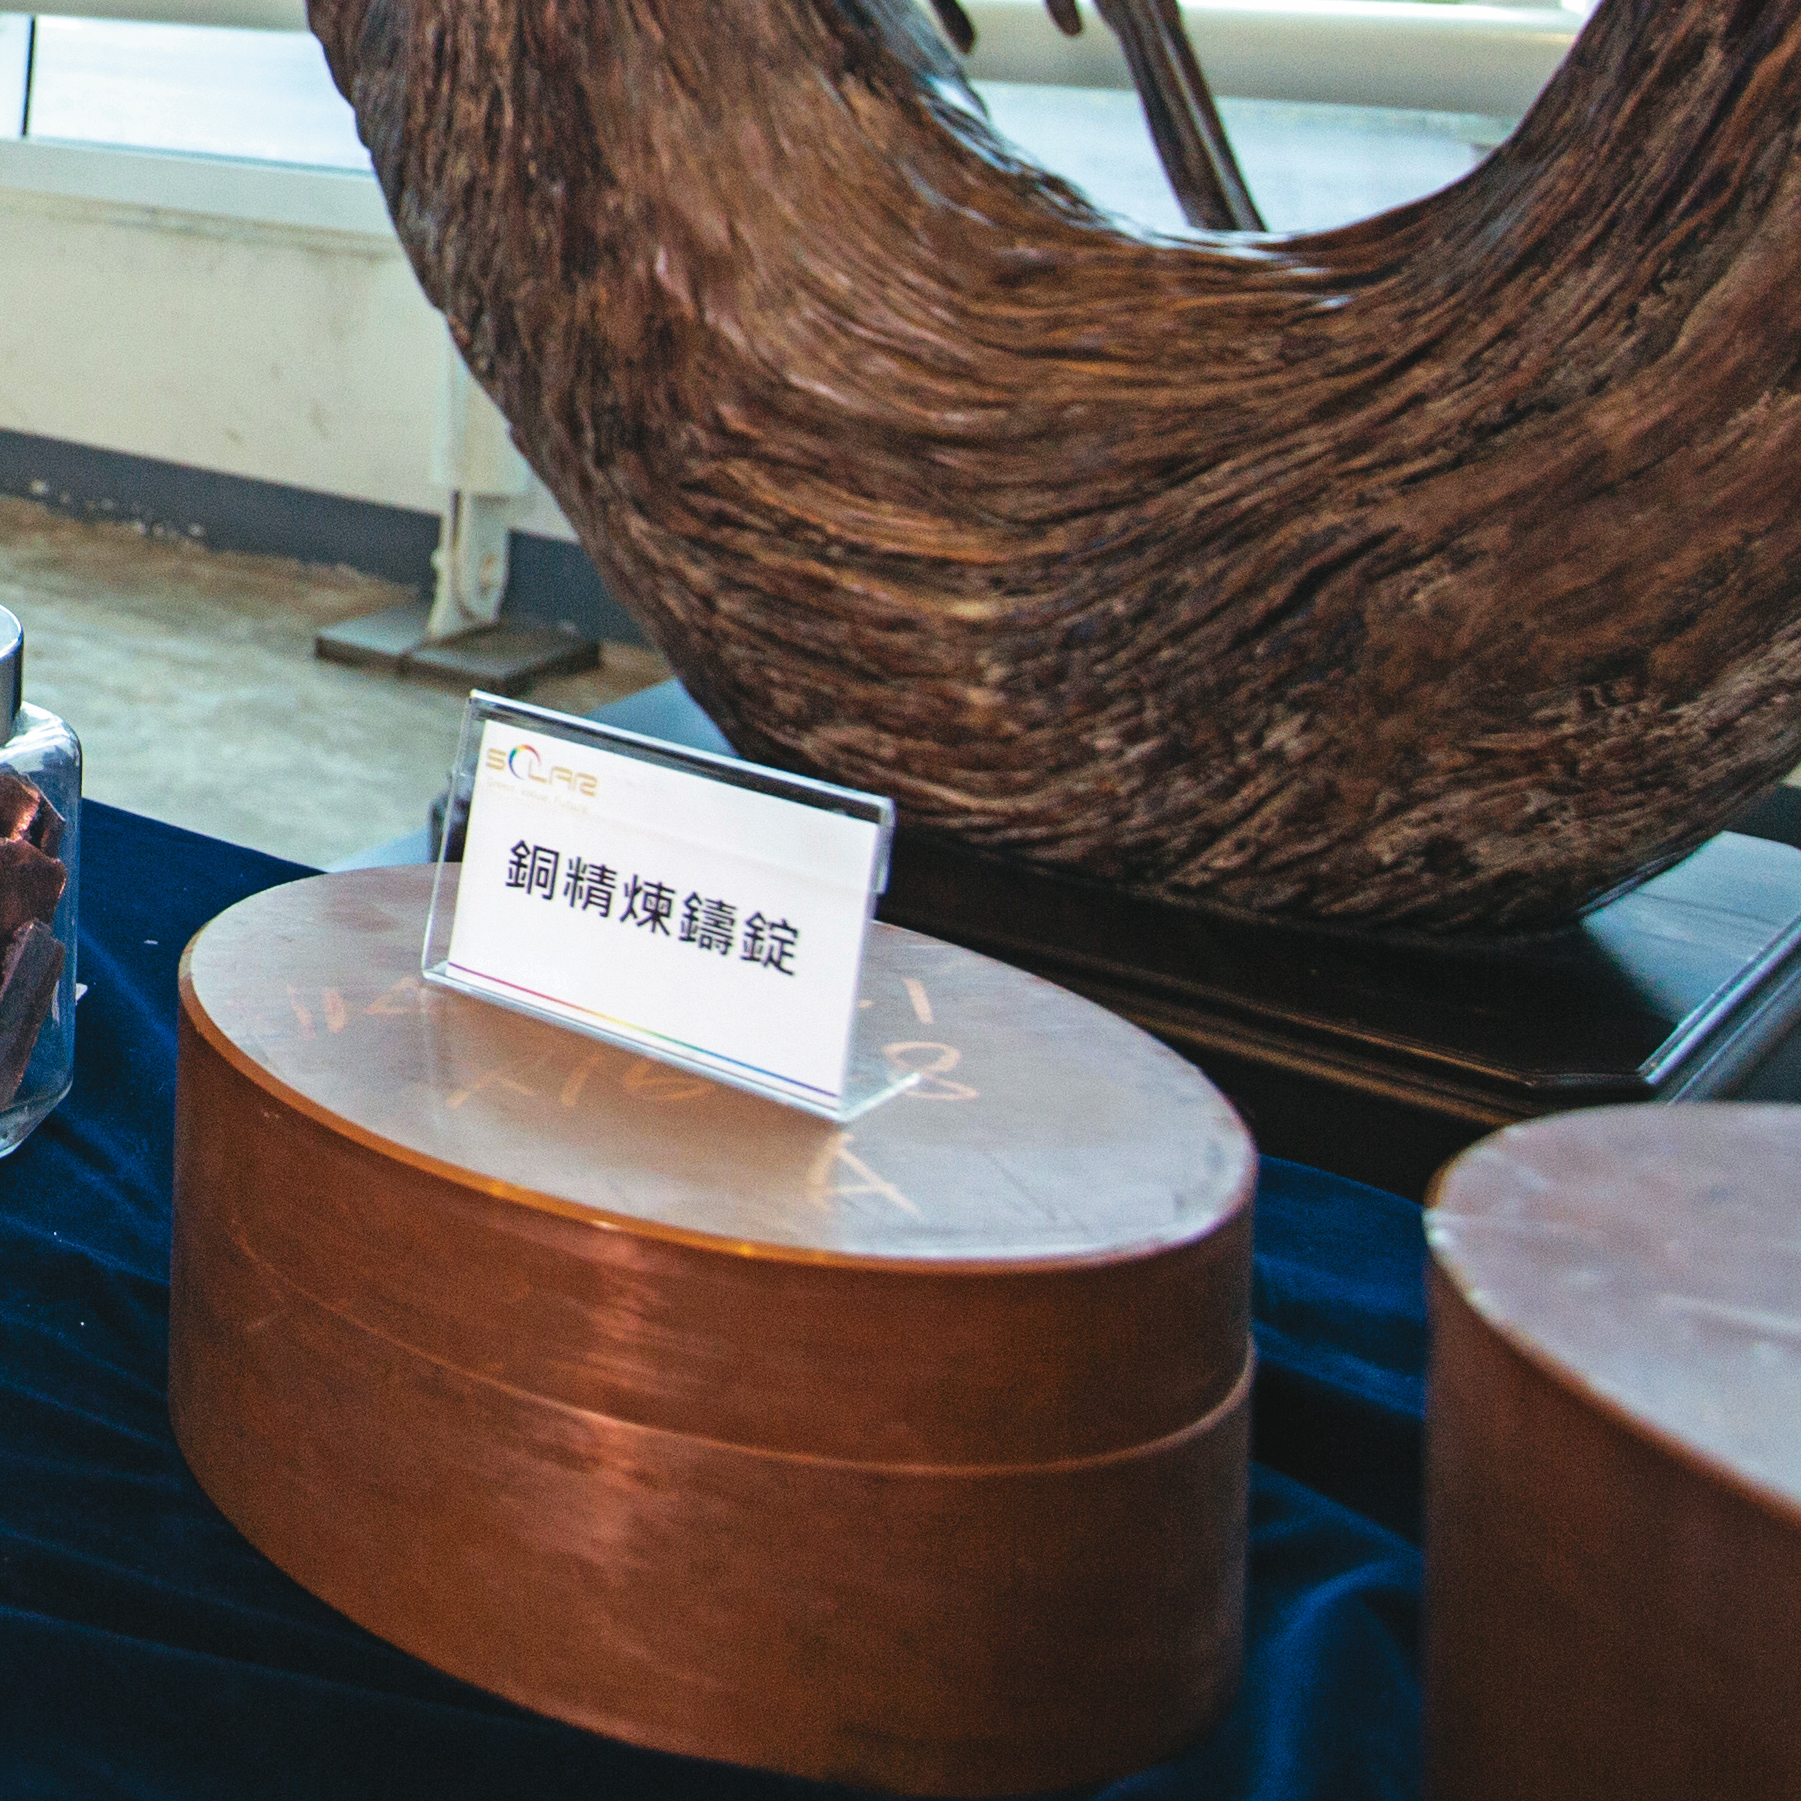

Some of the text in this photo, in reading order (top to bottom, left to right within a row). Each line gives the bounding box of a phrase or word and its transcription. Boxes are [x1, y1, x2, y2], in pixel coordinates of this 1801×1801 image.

[504, 839, 800, 977] 銅精煉鑄錠
